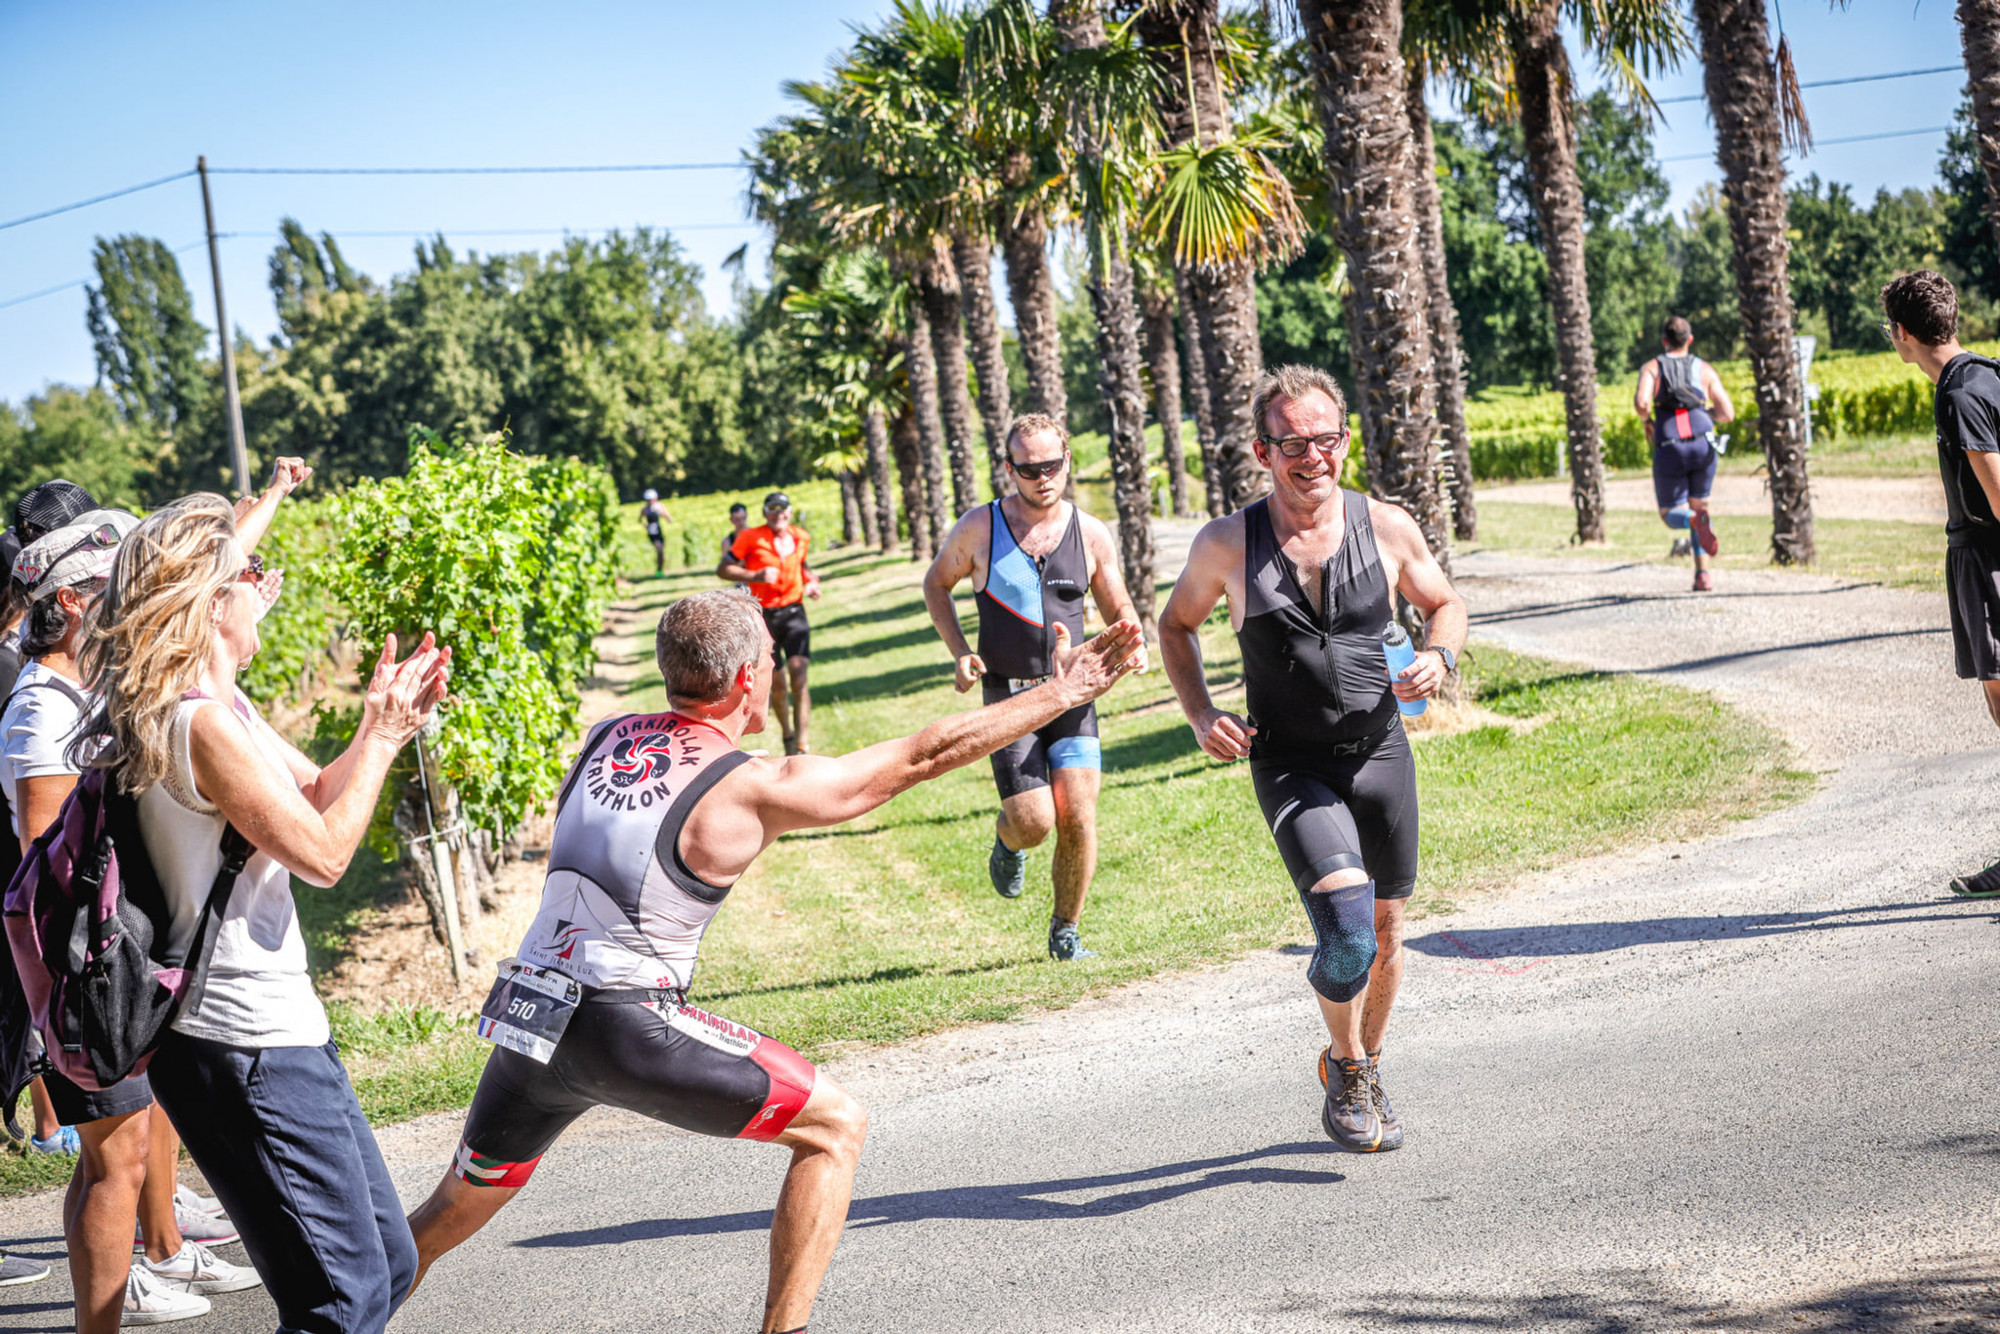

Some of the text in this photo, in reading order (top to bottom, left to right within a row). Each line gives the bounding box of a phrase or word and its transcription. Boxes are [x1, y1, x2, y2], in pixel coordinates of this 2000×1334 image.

[616, 717, 702, 766] URKIROLAK
[587, 754, 671, 811] TRIATHLON
[508, 997, 537, 1020] 510
[718, 1033, 749, 1050] Triathlon
